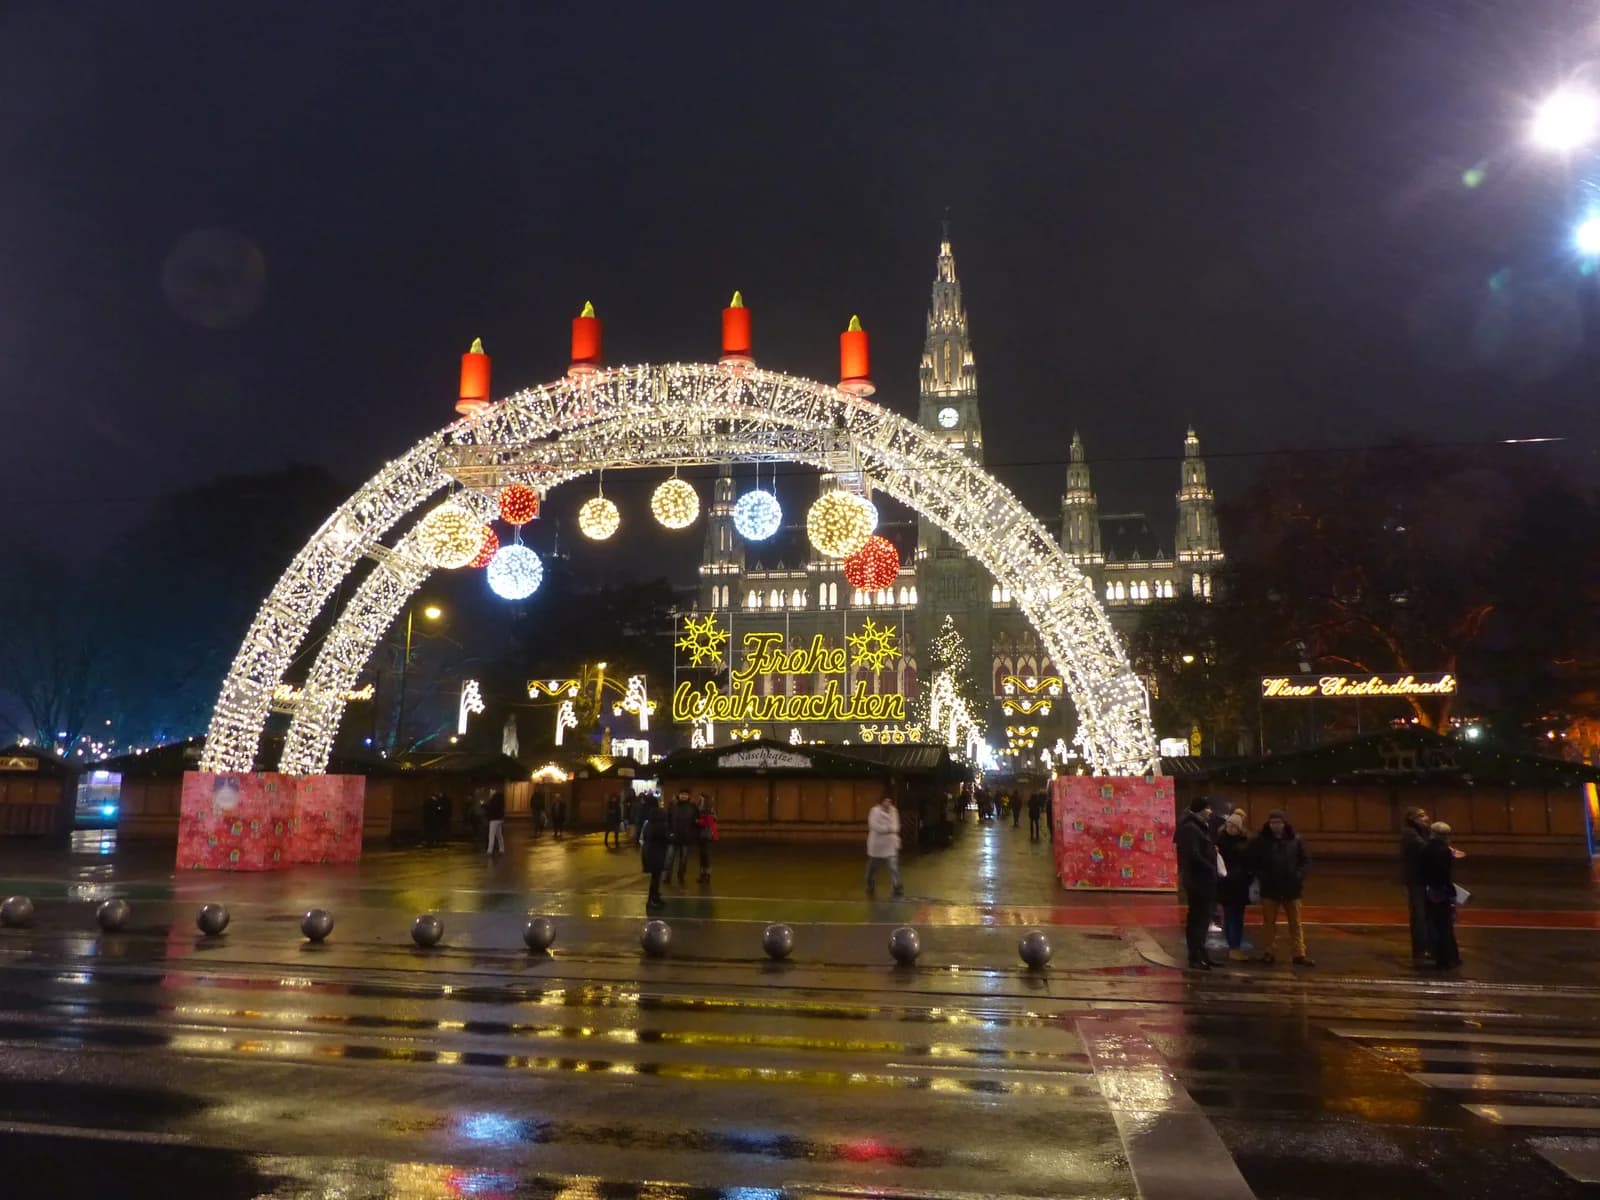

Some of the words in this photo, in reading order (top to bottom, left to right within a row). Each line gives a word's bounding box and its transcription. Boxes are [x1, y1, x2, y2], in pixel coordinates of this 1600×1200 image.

[731, 632, 847, 681] Frohe
[673, 679, 906, 721] Weihnachten
[1262, 678, 1318, 697] Wiener
[1319, 674, 1457, 697] Christkindlmarkt
